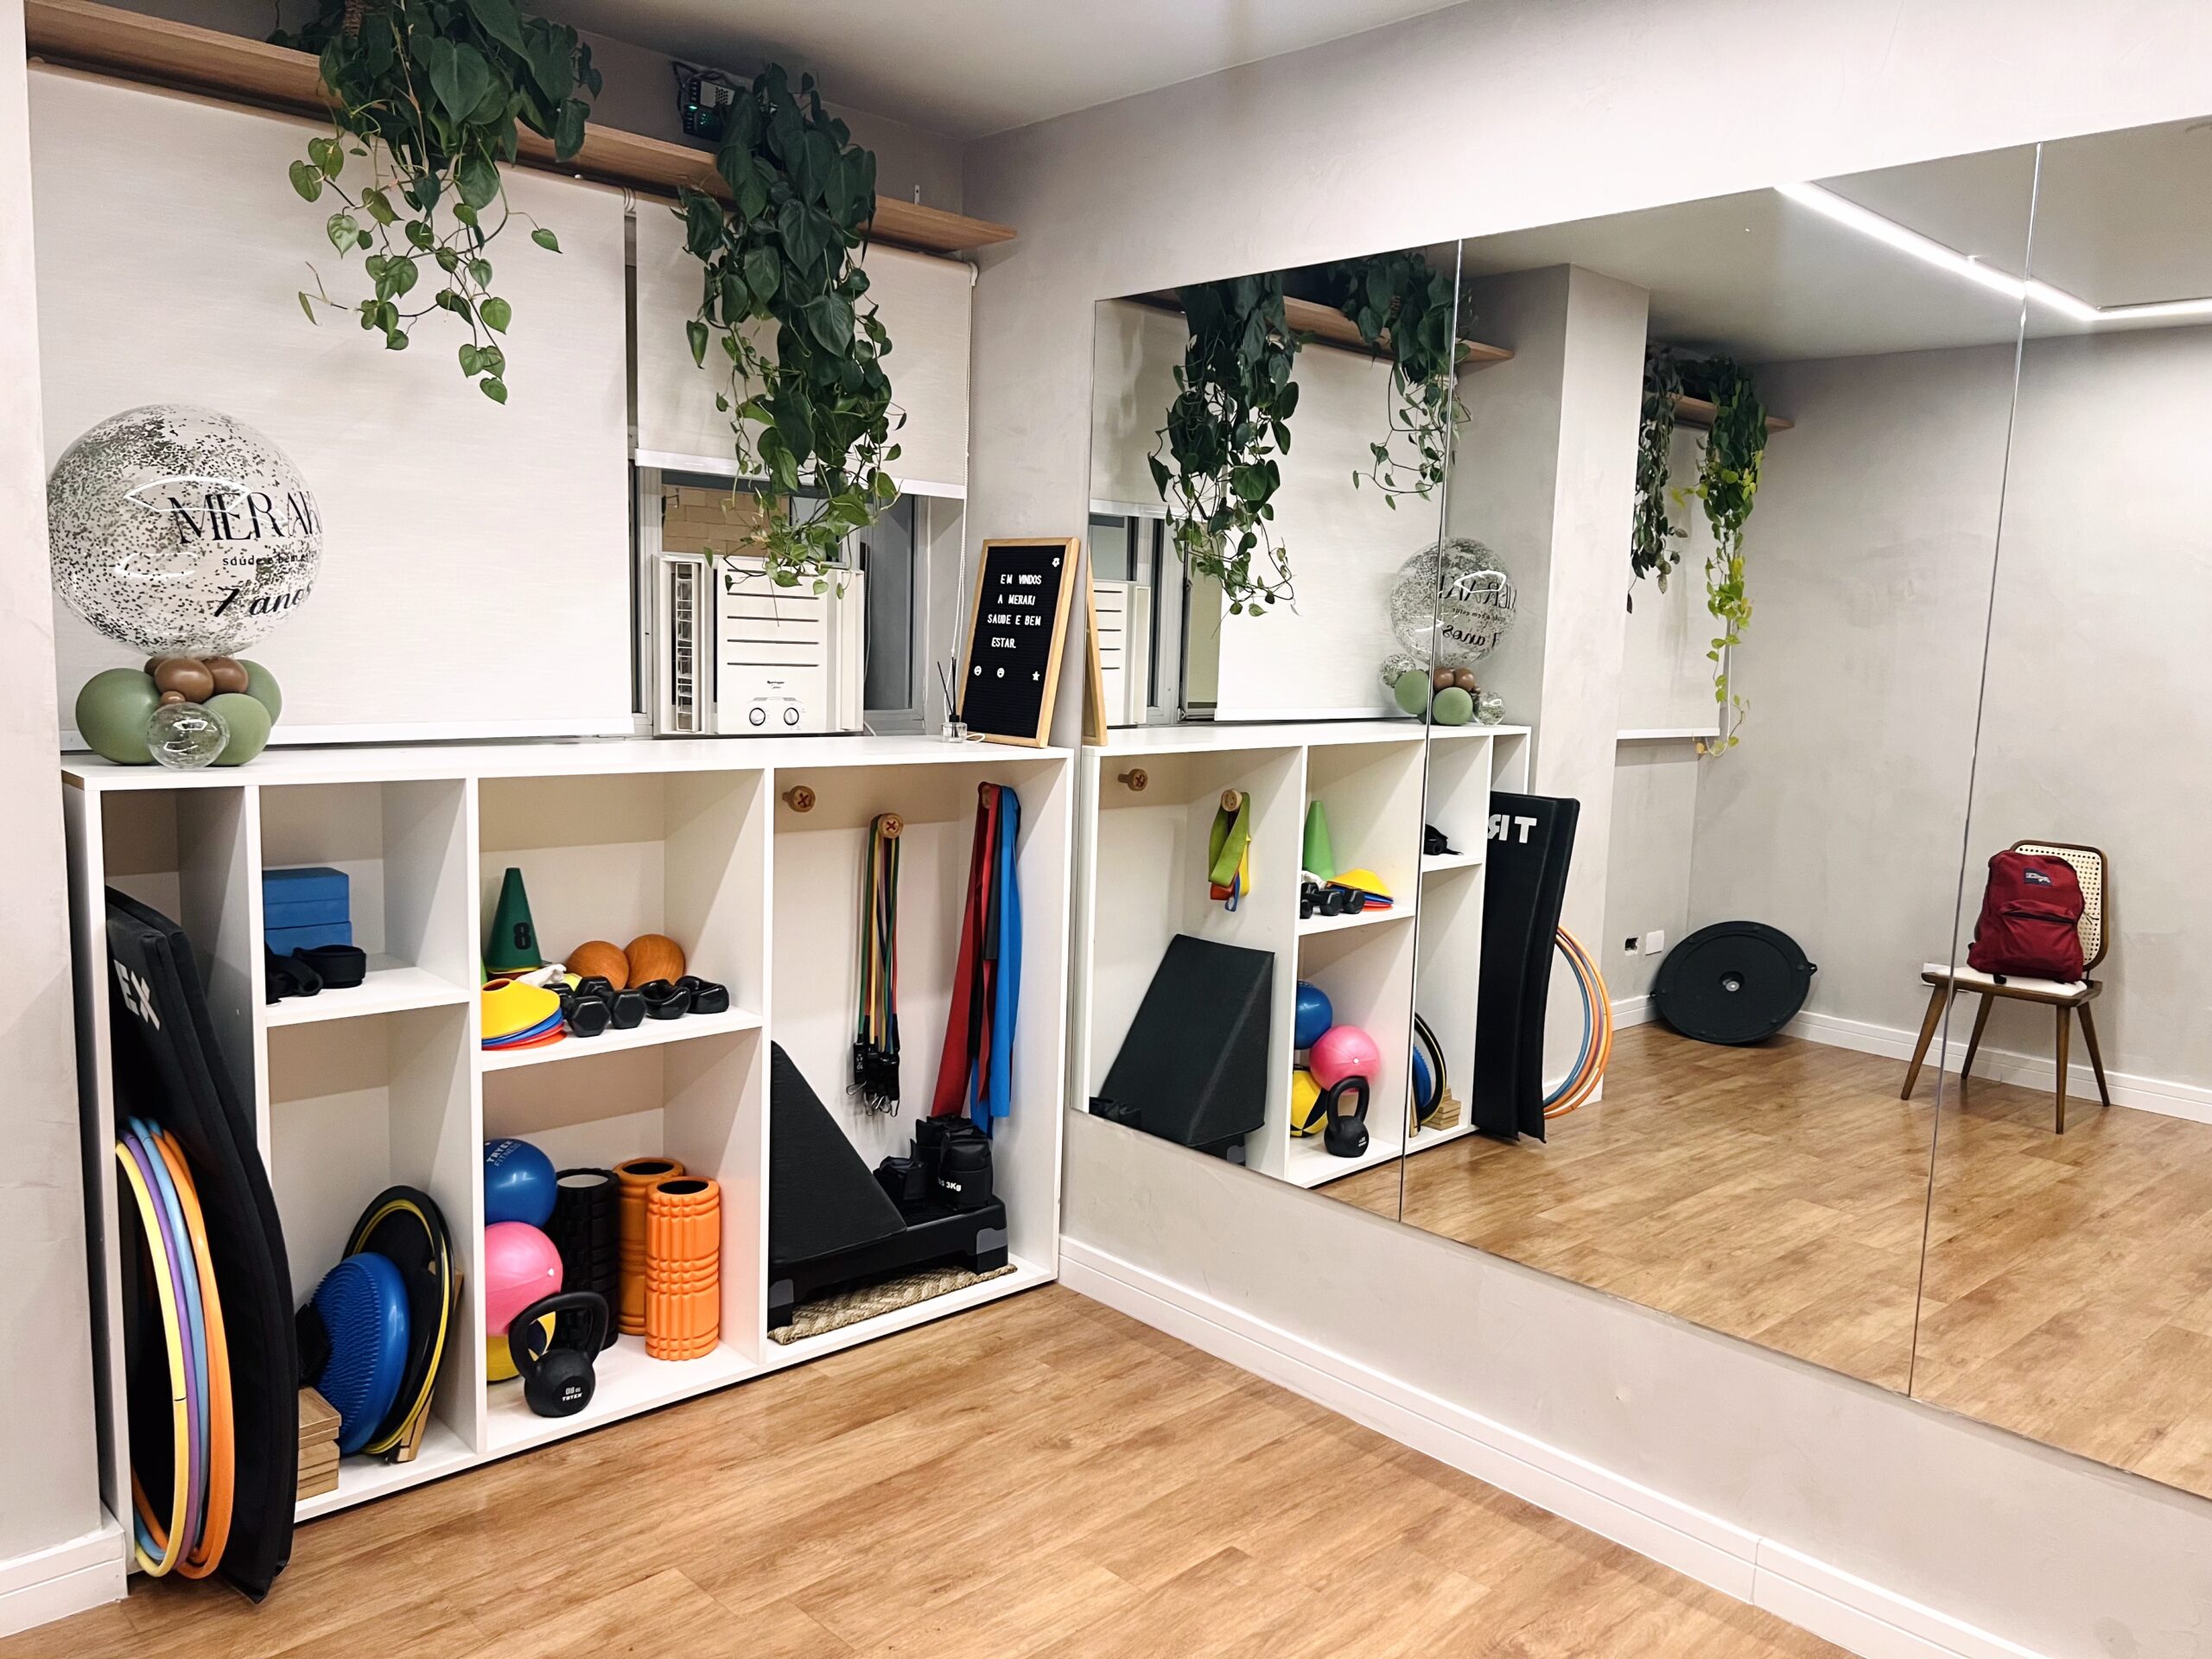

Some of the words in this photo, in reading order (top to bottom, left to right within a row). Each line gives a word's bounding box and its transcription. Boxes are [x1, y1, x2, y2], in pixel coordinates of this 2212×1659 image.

[1000, 574, 1013, 584] EM
[1019, 574, 1042, 585] VINDOS
[214, 586, 241, 617] 7
[997, 594, 1003, 605] A
[1007, 594, 1036, 606] MERAKI
[987, 613, 1012, 625] SAUDE
[1014, 614, 1021, 626] E
[1024, 614, 1041, 626] BEM
[990, 637, 1017, 649] ESTAR.
[513, 922, 531, 950] 8
[486, 1141, 514, 1163] TRYEX
[945, 1180, 962, 1192] 3Kg
